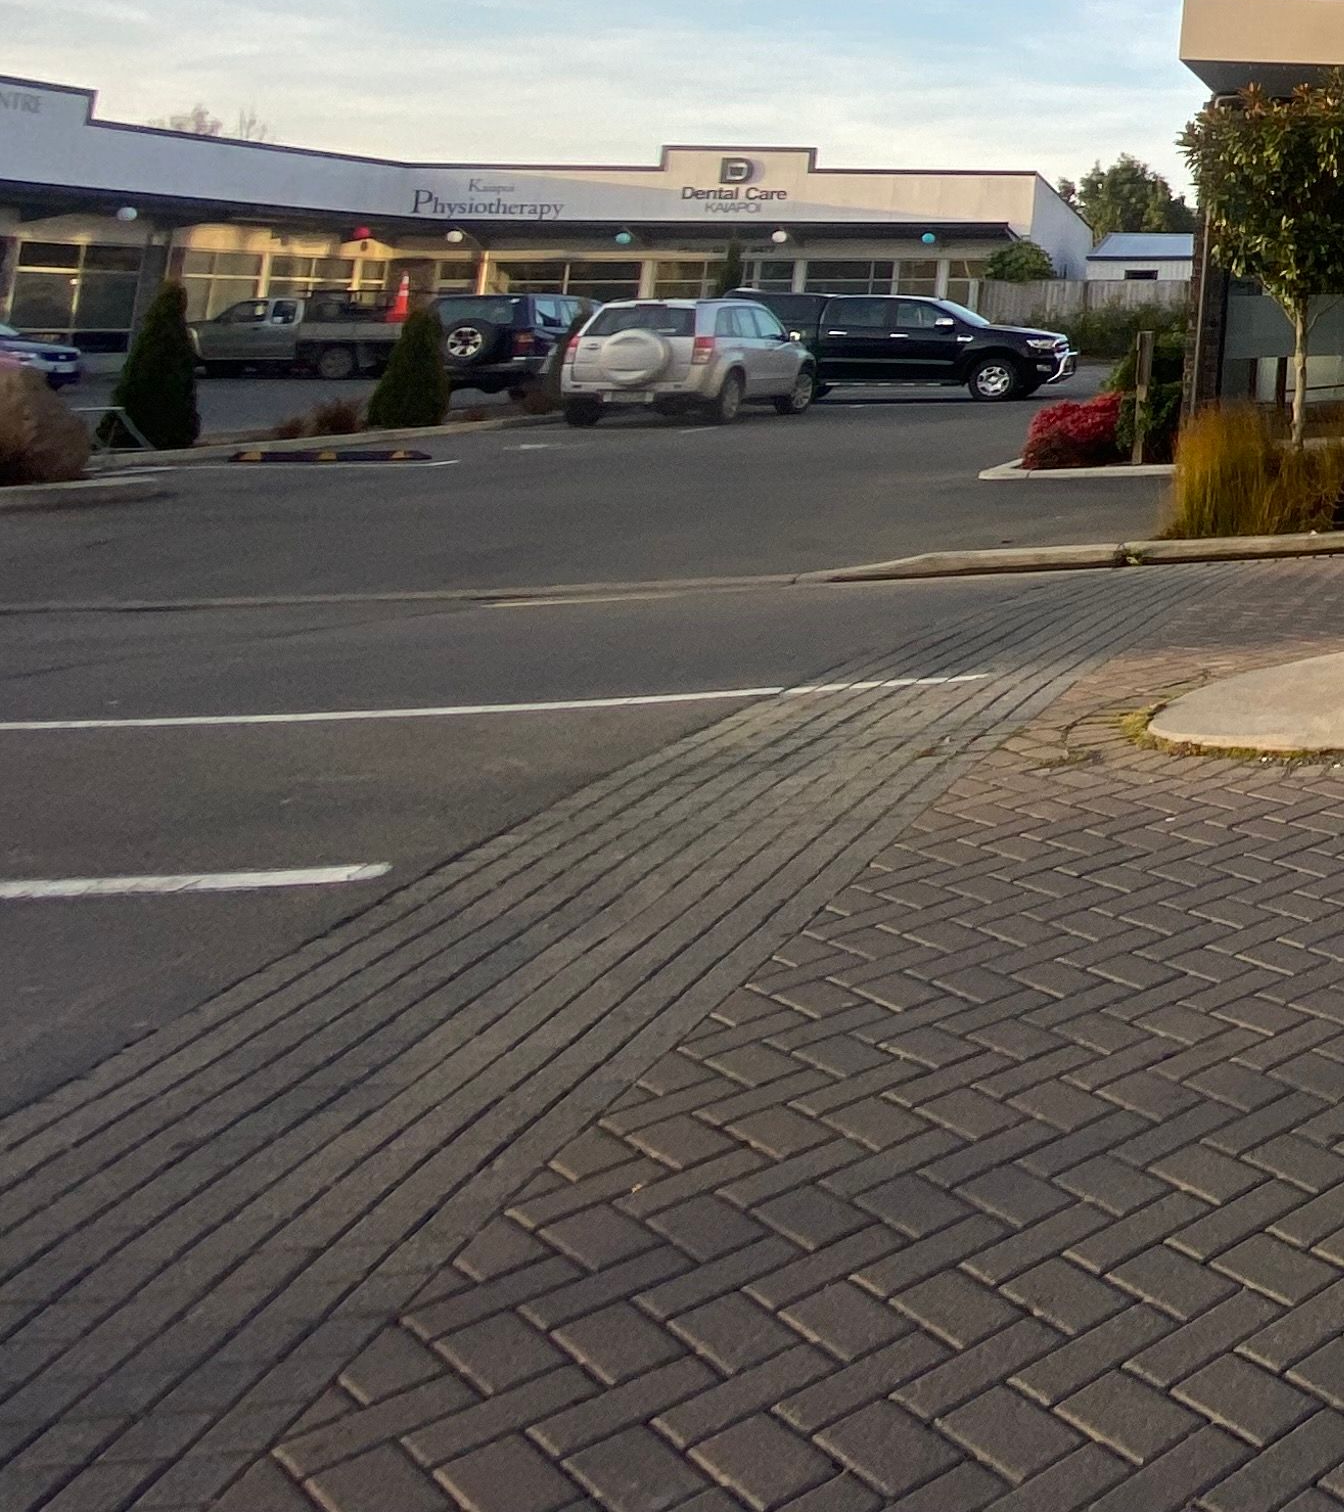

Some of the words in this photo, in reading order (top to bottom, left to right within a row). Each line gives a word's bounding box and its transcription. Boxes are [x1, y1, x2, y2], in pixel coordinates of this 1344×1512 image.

[681, 187, 739, 200] Dental
[745, 187, 788, 200] Care
[410, 189, 564, 220] Physiotherapy
[704, 202, 762, 214] KAIAPOI
